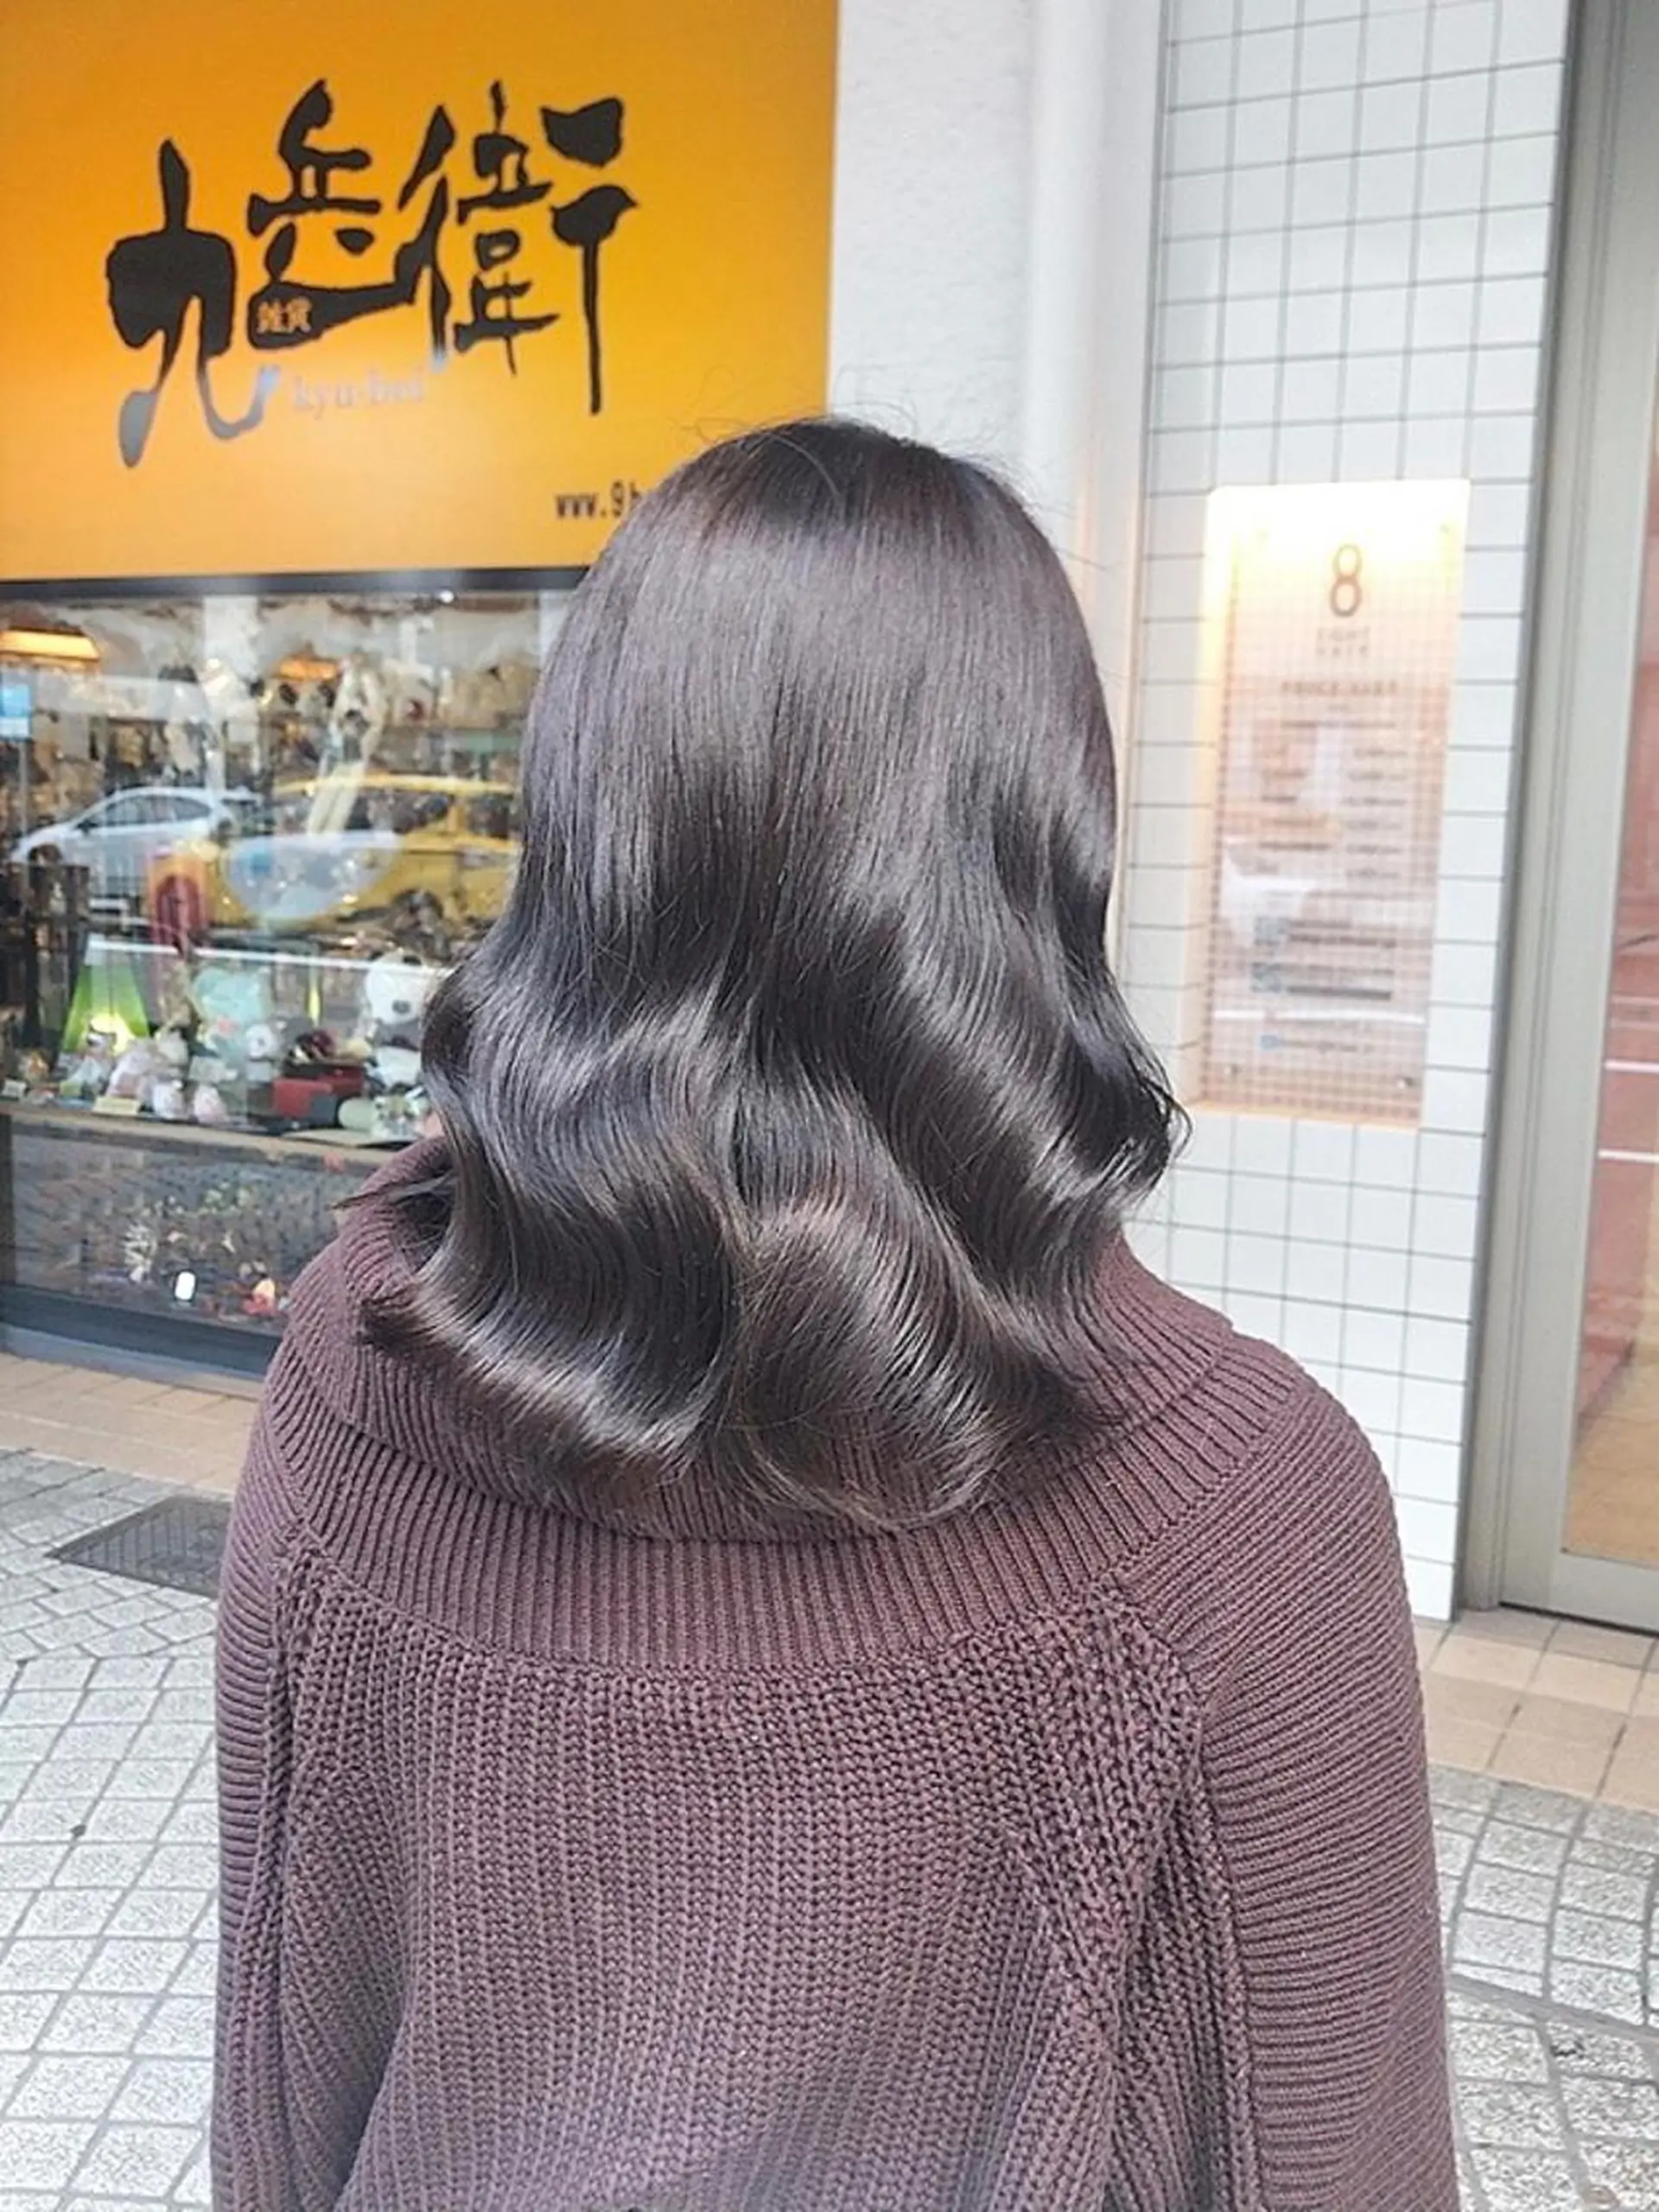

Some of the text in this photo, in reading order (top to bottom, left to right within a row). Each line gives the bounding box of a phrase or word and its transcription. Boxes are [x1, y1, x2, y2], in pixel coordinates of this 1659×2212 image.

[105, 79, 639, 468] 九兵衛
[1329, 543, 1363, 618] 8
